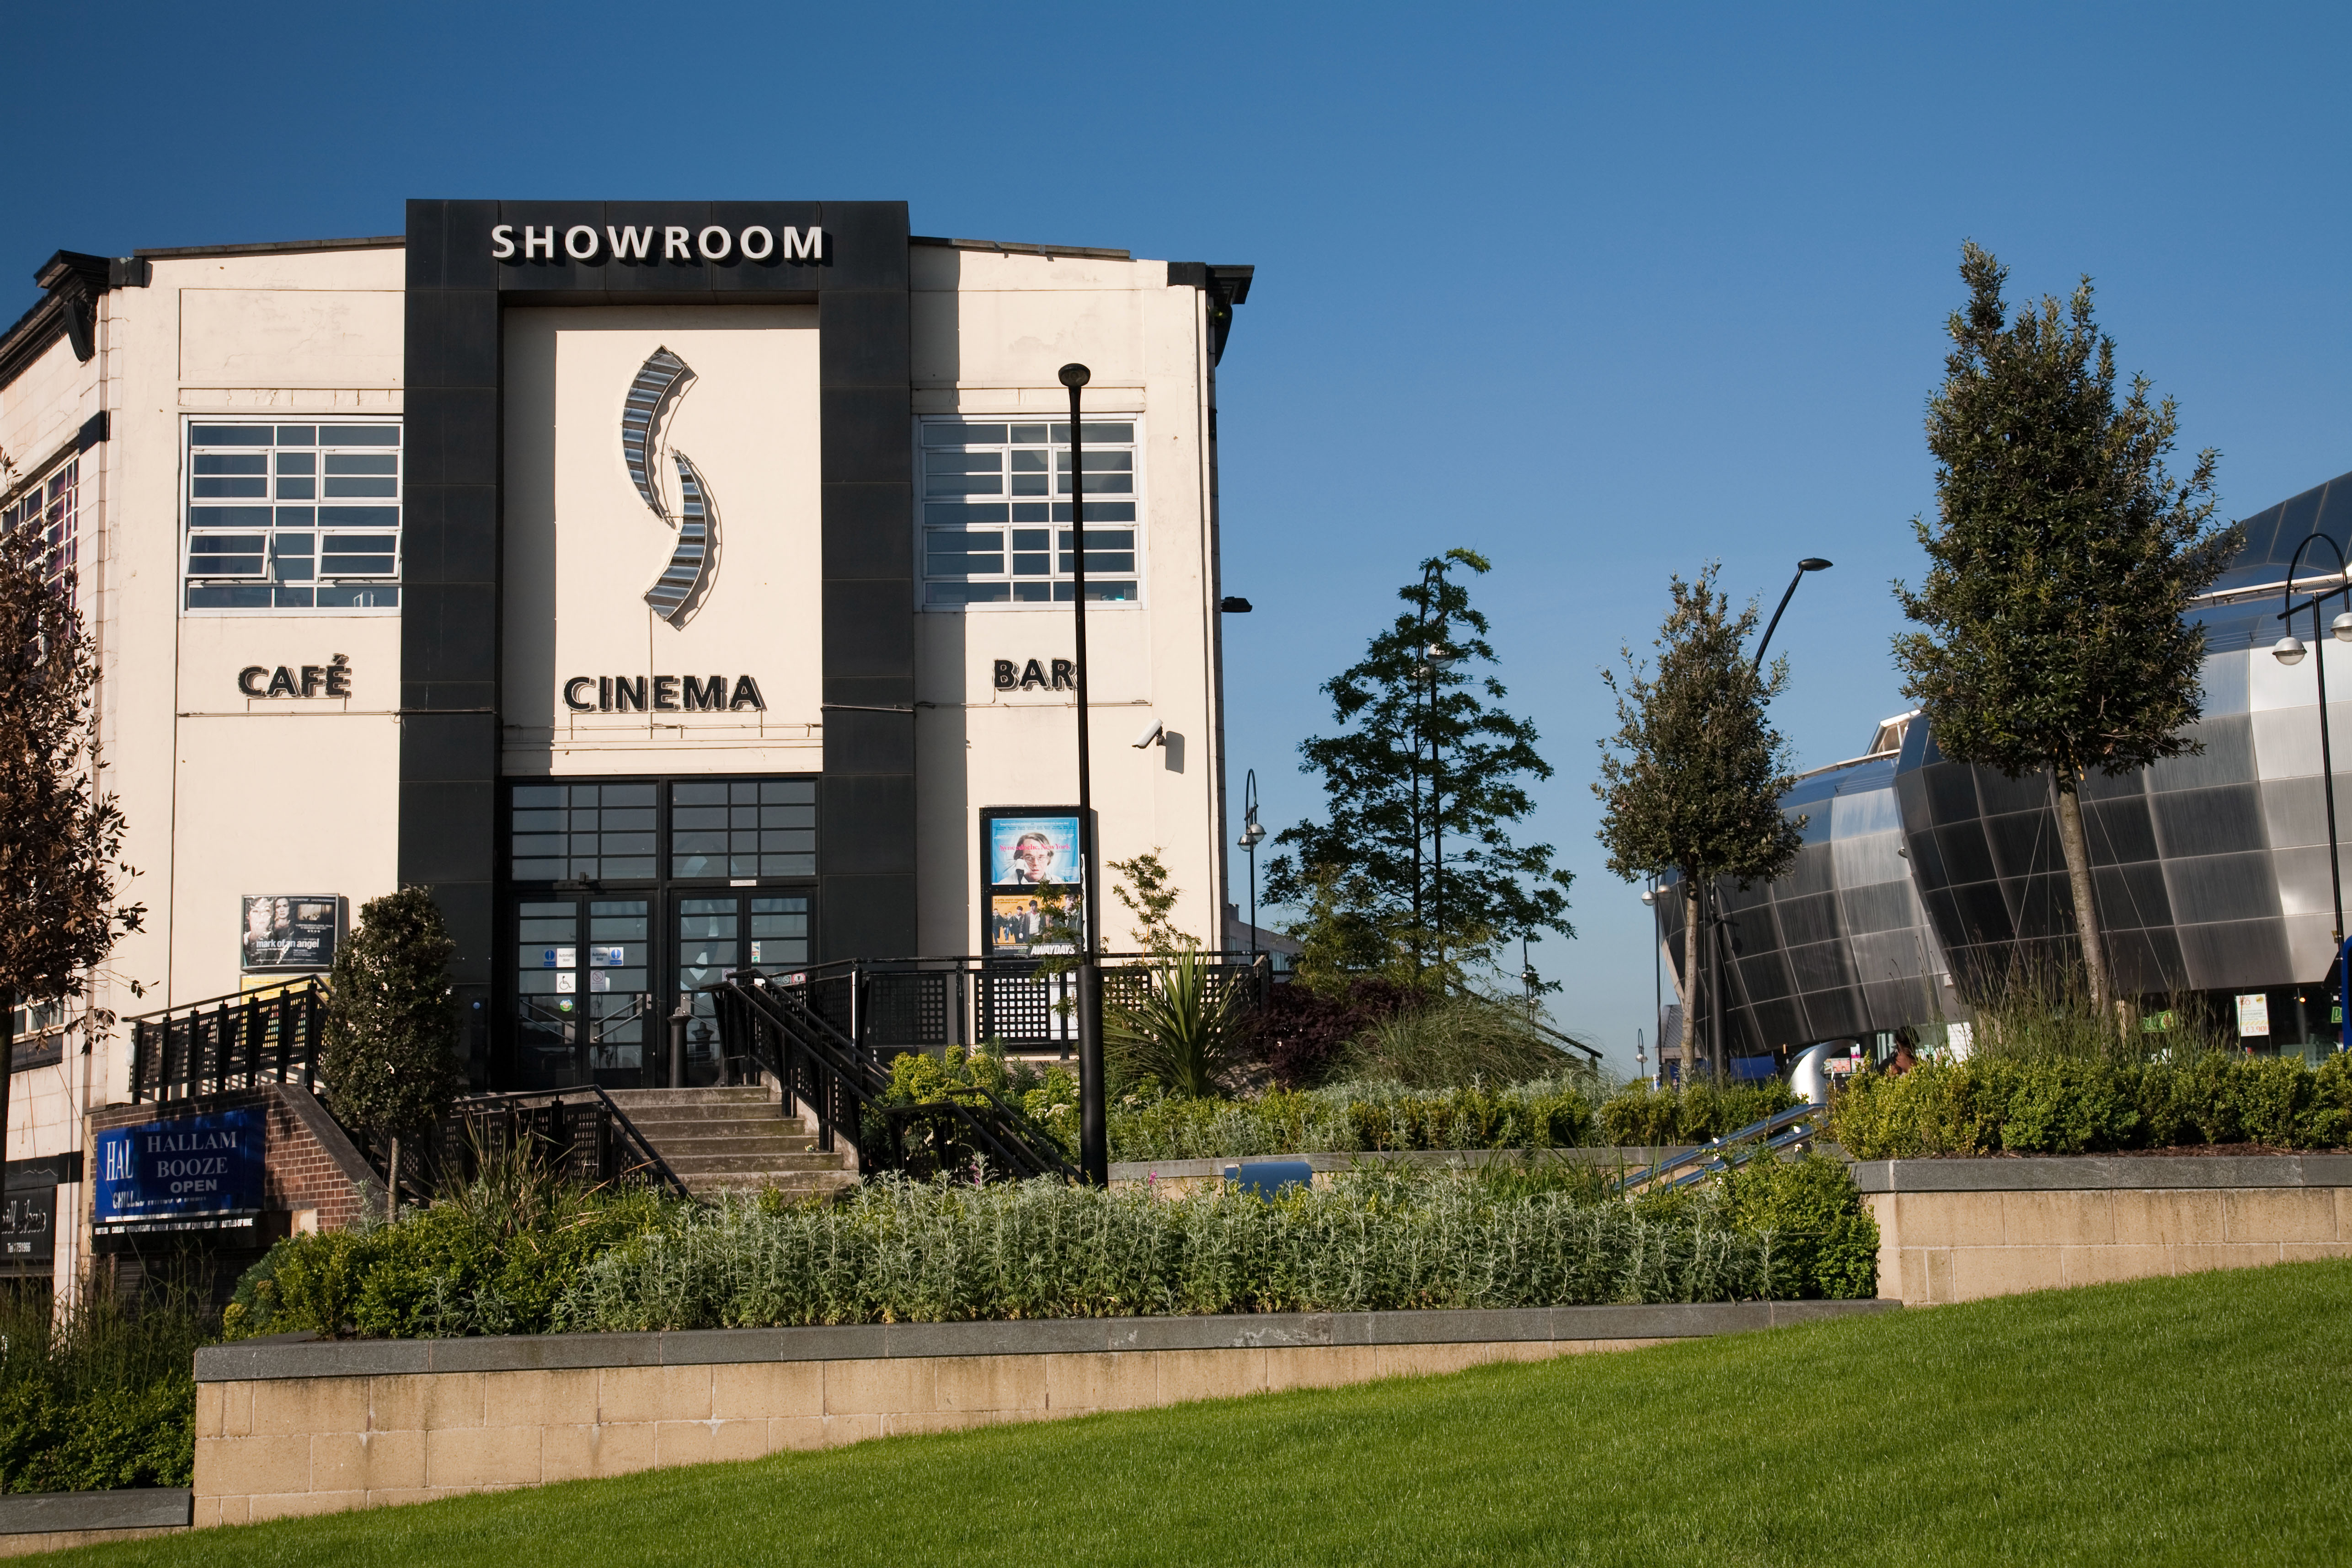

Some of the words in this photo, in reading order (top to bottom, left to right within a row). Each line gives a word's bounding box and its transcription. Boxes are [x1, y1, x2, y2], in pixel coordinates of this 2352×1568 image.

[492, 225, 823, 261] SHOWROOM
[238, 653, 349, 696] CAFÉ
[993, 658, 1077, 690] BAR
[563, 674, 764, 711] CINEMA
[257, 939, 276, 948] mark
[277, 939, 285, 947] of
[296, 938, 319, 949] angel
[1031, 945, 1075, 955] AWAYDAYS
[146, 1131, 237, 1153] HALLAM
[157, 1157, 228, 1178] BOOZE
[170, 1179, 217, 1194] OPEN
[221, 1219, 237, 1228] BOTTLES
[237, 1219, 243, 1227] OF
[243, 1218, 253, 1226] WINE
